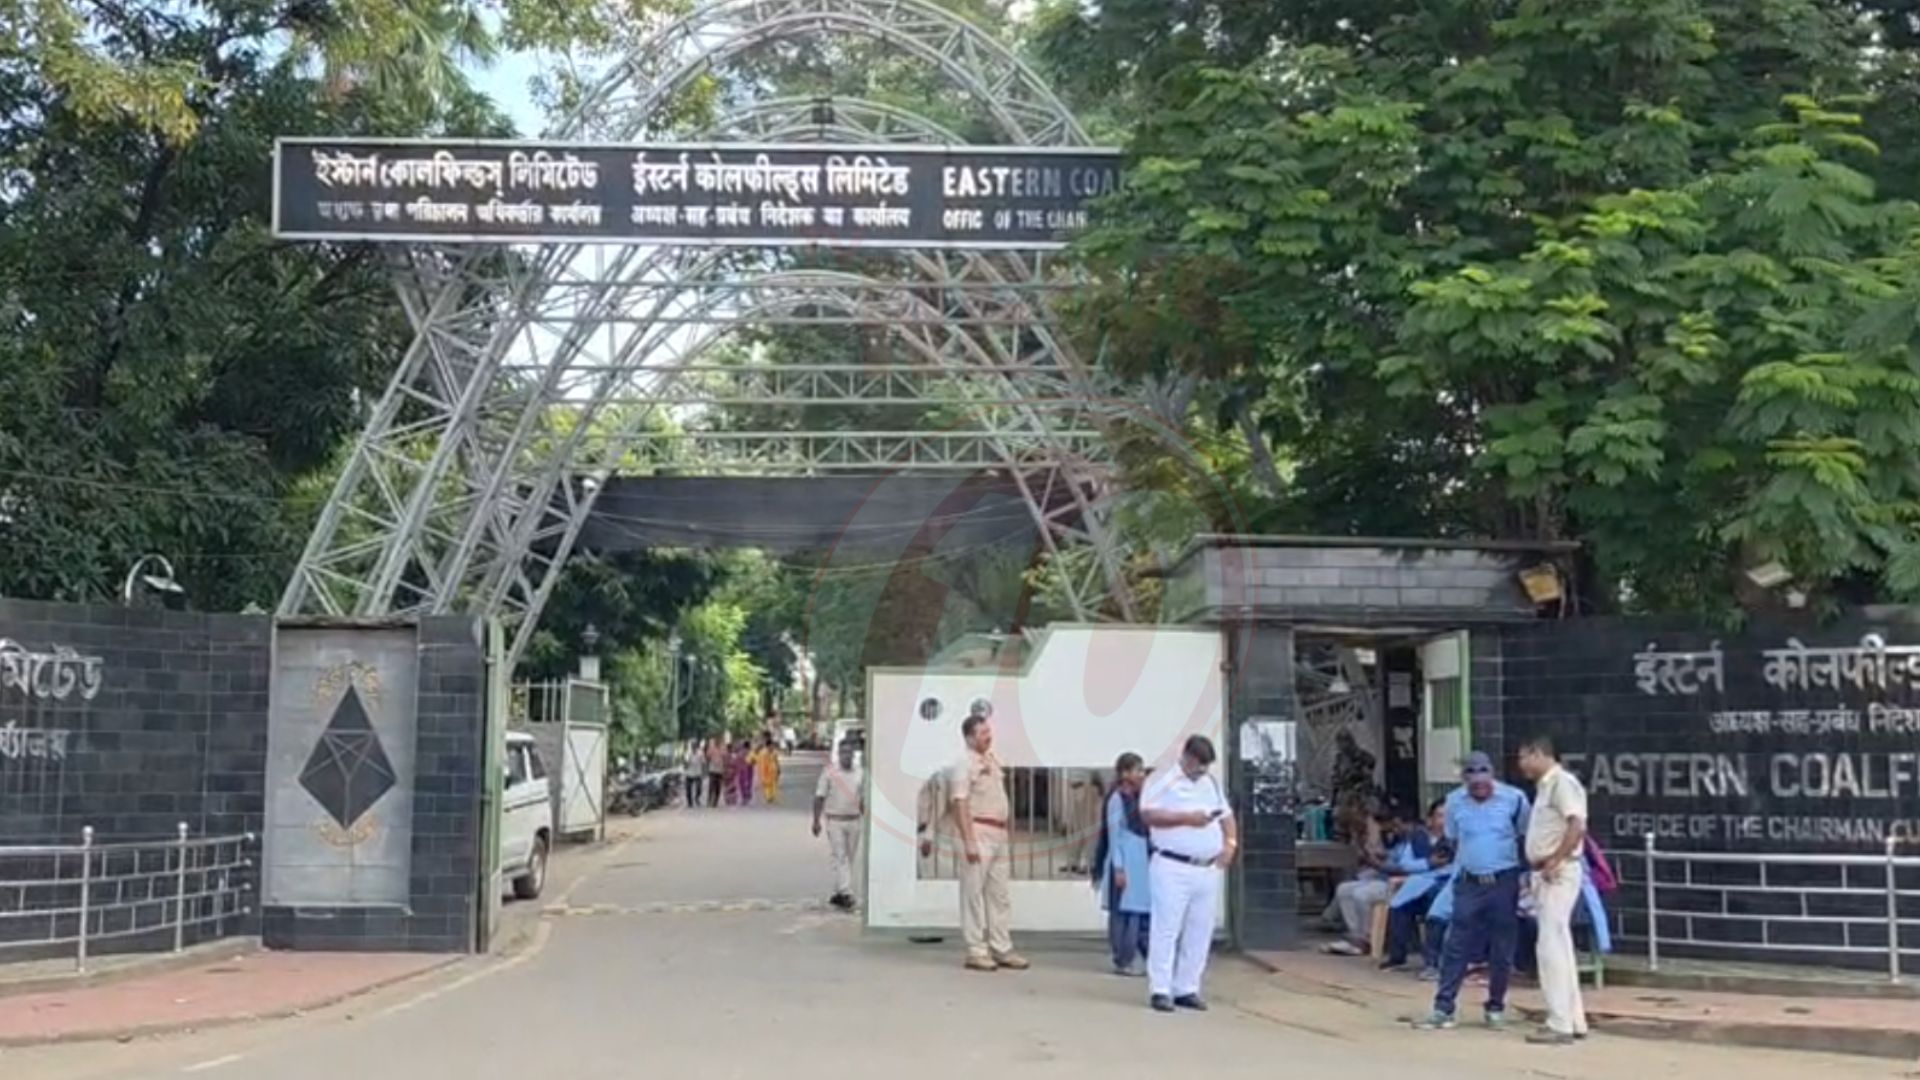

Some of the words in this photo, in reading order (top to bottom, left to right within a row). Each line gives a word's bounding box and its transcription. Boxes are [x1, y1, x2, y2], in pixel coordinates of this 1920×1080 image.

[509, 150, 600, 189] লিমিটেড
[631, 152, 689, 195] ईस्टर्न
[826, 155, 911, 195] लिमिटेड
[942, 166, 1061, 197] EASTERN
[994, 209, 1012, 231] OF
[1016, 209, 1044, 230] THE
[1633, 641, 1723, 695] ईस्टर्न
[1689, 814, 1716, 839] OF
[1721, 814, 1763, 840] THE
[1768, 816, 1884, 843] CHAIRMAN
